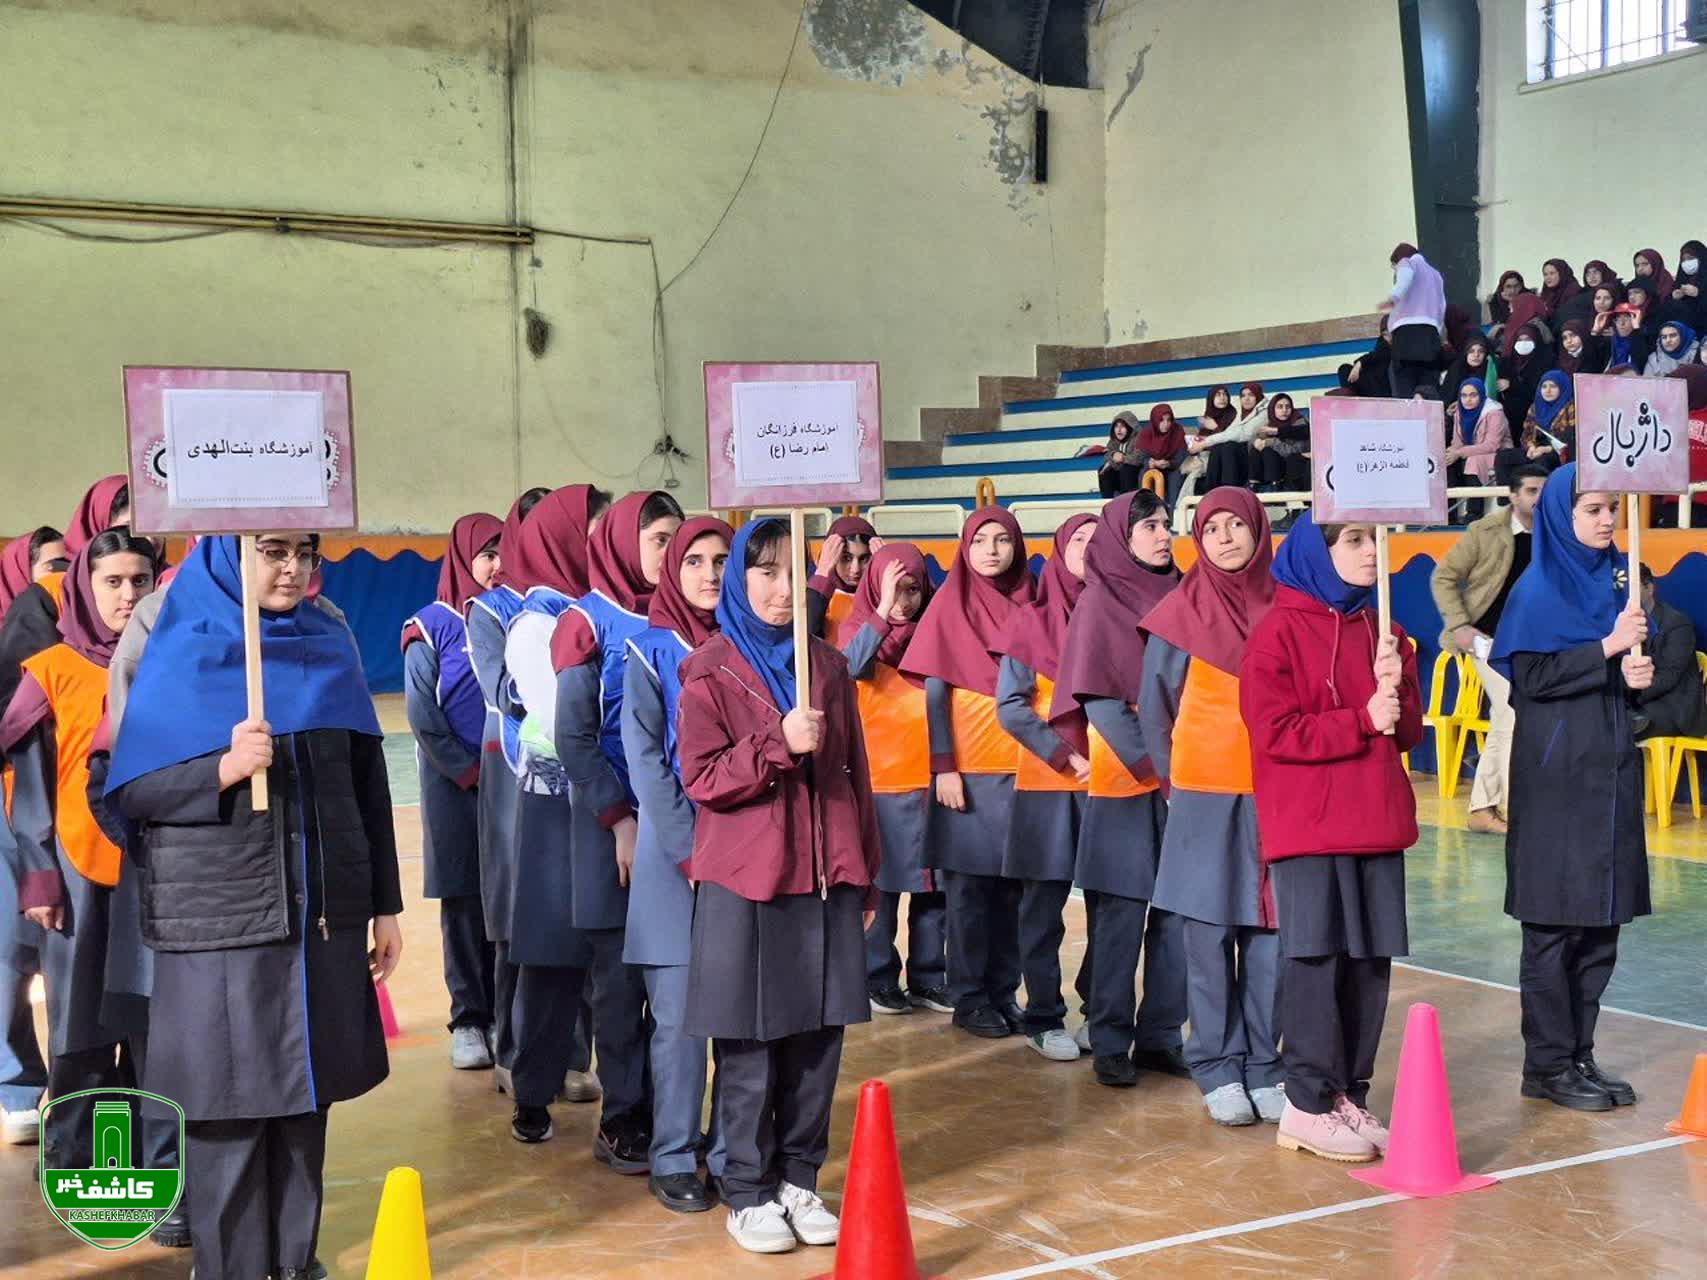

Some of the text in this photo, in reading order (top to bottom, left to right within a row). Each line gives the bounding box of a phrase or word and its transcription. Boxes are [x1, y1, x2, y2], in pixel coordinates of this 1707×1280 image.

[1592, 402, 1672, 468] داژبال
[259, 440, 313, 458] آموزشگاه
[789, 442, 809, 455] رضا
[812, 442, 830, 454] امام
